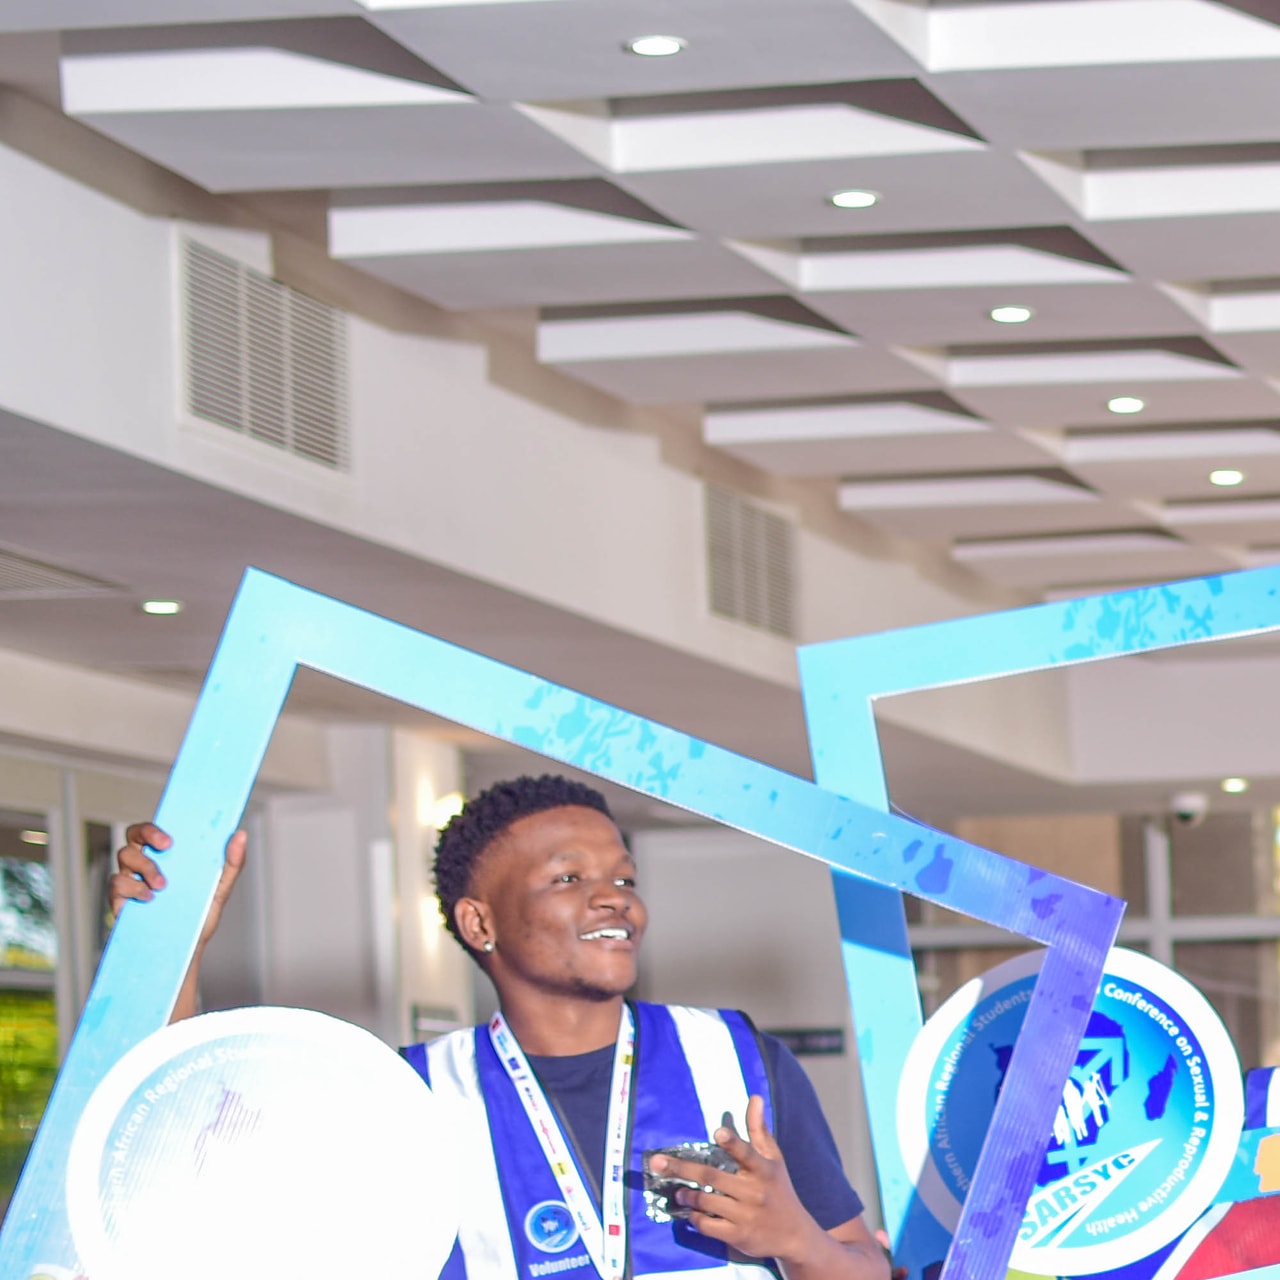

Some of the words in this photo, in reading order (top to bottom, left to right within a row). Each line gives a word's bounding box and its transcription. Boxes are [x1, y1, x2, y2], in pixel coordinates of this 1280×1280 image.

[1104, 983, 1179, 1036] Conference
[936, 1028, 976, 1090] Regional
[1177, 1035, 1192, 1057] on
[1186, 1056, 1209, 1109] Sexual
[934, 1091, 947, 1149] African
[1195, 1111, 1208, 1123] &
[1139, 1128, 1206, 1213] Reproductive
[1087, 1210, 1139, 1236] Health
